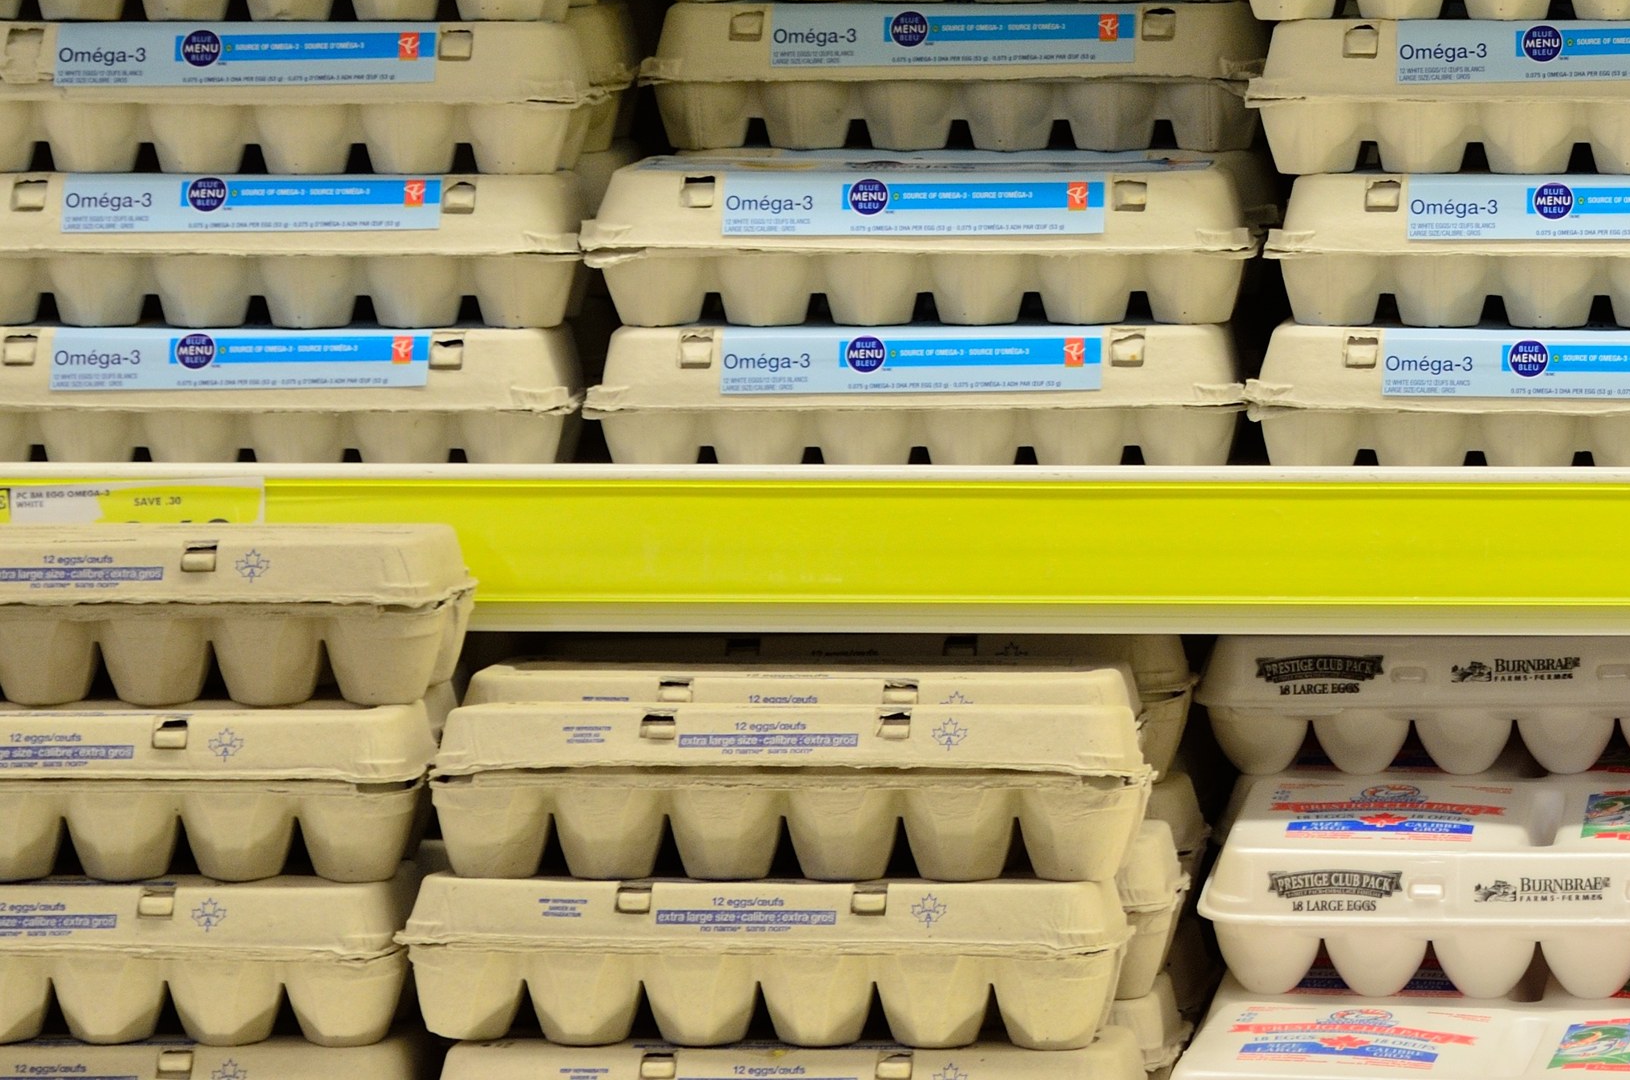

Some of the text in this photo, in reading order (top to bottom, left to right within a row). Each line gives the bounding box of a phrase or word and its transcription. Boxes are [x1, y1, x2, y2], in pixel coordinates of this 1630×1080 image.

[774, 27, 857, 46] Oméga-3
[58, 47, 146, 66] Oméga-3
[1399, 43, 1487, 62] Oméga-3
[65, 192, 152, 211] Oméga-3
[726, 194, 813, 213] Oméga-3
[1410, 198, 1498, 218] Oméga-3
[54, 349, 141, 368] Oméga-3
[724, 352, 811, 371] Oméga-3
[1386, 355, 1473, 374] Oméga-3
[46, 491, 65, 499] EGG
[134, 497, 161, 506] SAVE
[712, 898, 724, 906] 12
[658, 912, 835, 924] extra large size calibre extra gros
